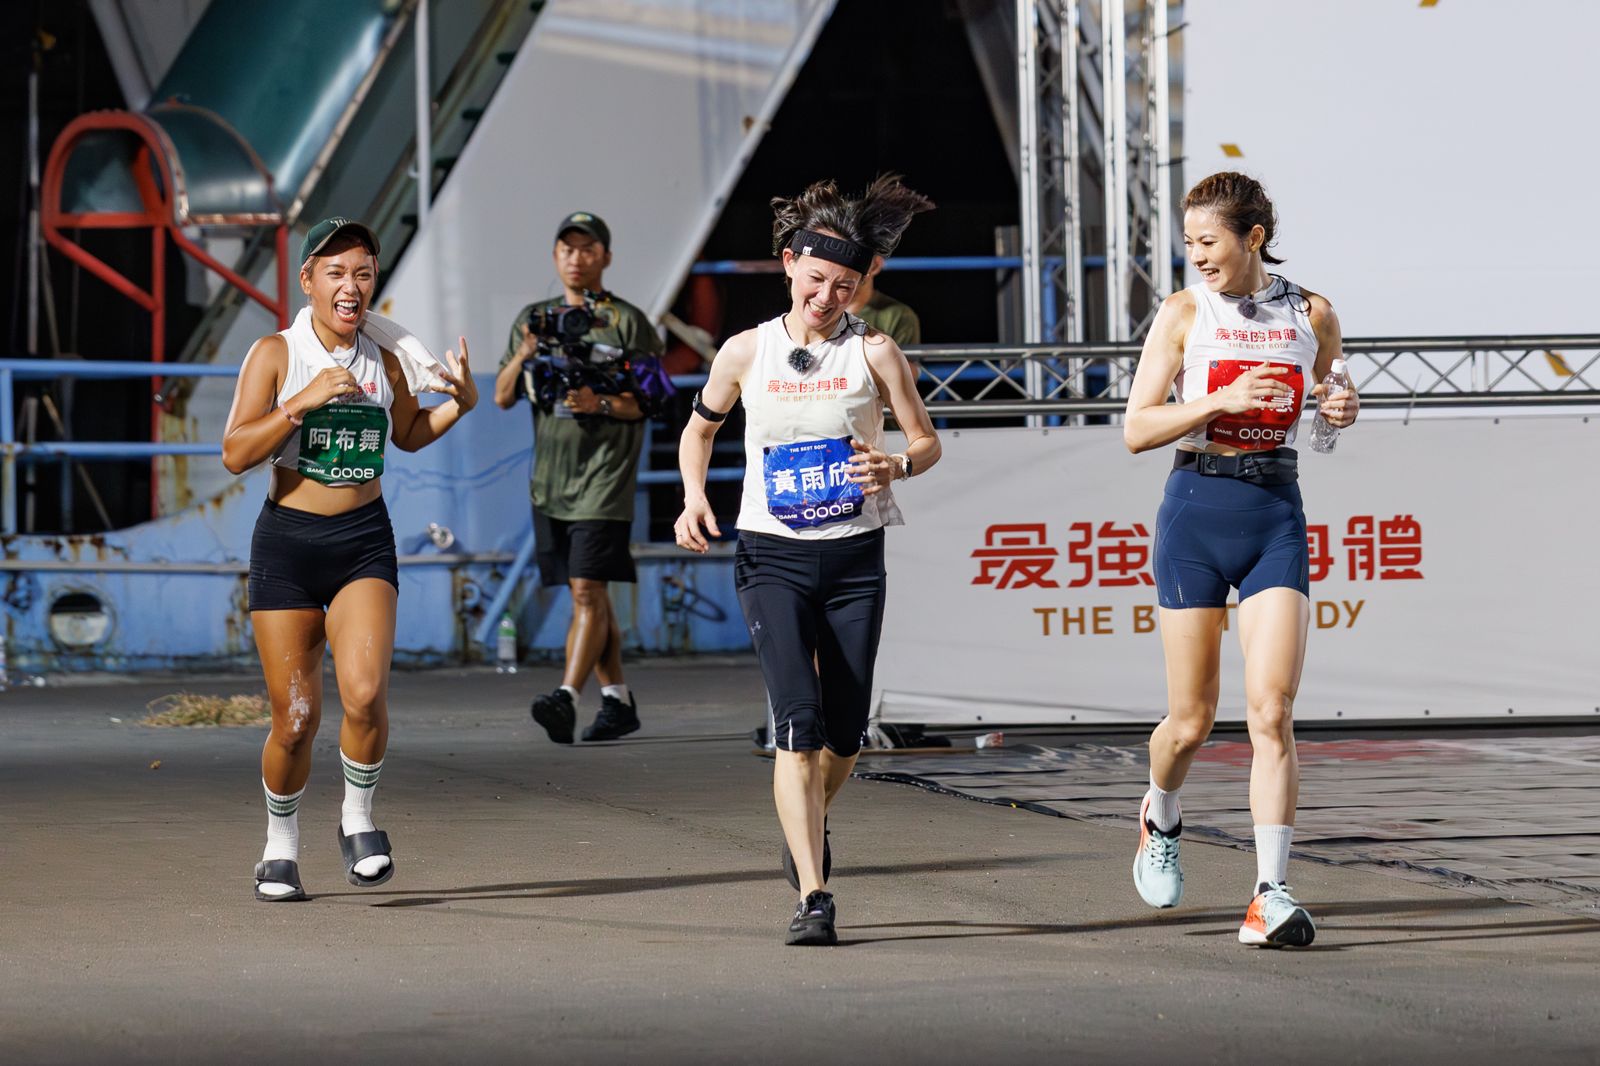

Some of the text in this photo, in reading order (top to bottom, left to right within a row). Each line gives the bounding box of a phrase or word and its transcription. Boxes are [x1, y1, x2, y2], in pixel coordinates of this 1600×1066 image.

[1215, 328, 1297, 342] 最強的身體
[767, 377, 848, 393] 最強的身體
[816, 393, 838, 401] BODY
[308, 427, 381, 452] 阿布舞
[1214, 427, 1233, 436] GAME
[330, 467, 375, 479] 0008
[803, 502, 854, 520] 0008
[970, 514, 1424, 589] 最強體
[1032, 606, 1114, 636] THE
